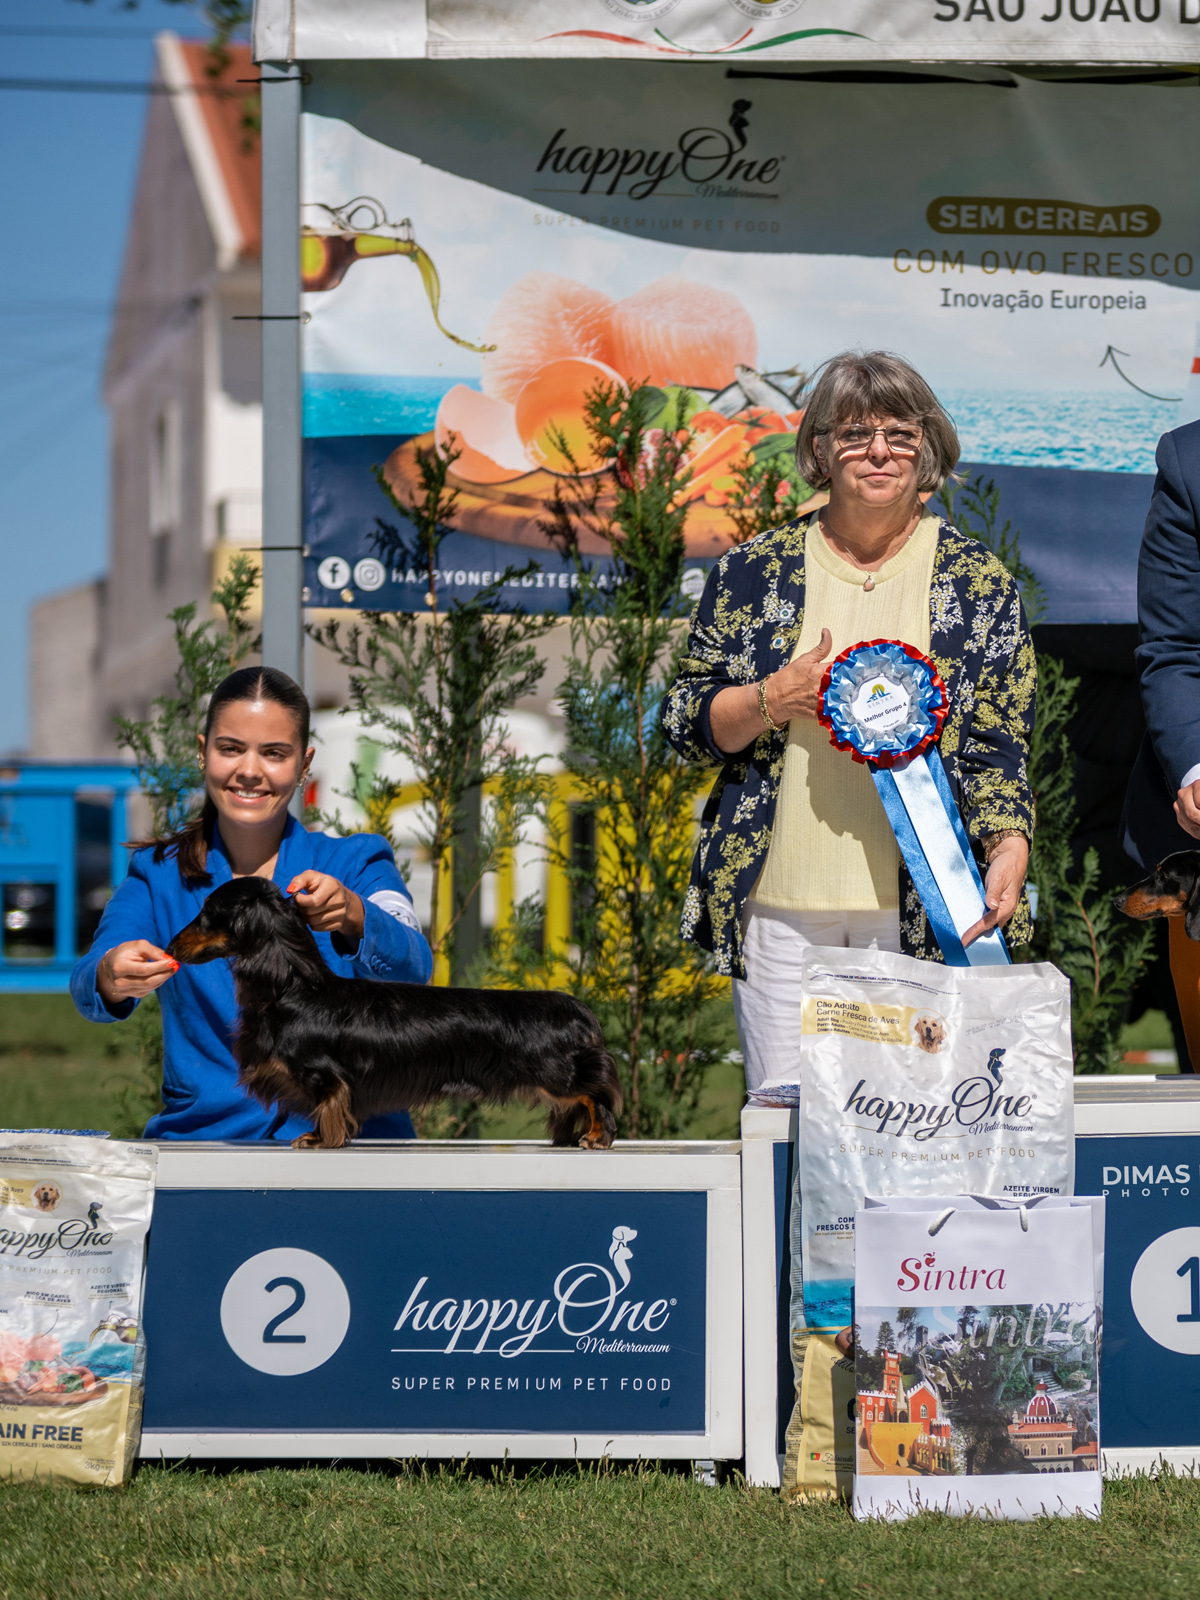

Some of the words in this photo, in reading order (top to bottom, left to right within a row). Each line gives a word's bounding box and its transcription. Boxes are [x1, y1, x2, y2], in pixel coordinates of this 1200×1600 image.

[533, 213, 590, 228] SUPER
[601, 215, 684, 230] PREMIUM
[692, 218, 725, 231] PET
[734, 219, 781, 233] FOOD
[938, 204, 1005, 229] SEM
[1014, 206, 1149, 232] CEREAIS
[893, 248, 964, 274] COM
[981, 250, 1046, 275] OVO
[1062, 251, 1194, 277] FRESCO
[940, 288, 1044, 313] Inovação
[1050, 290, 1147, 314] Europeia
[863, 711, 884, 723] Melhor
[884, 704, 903, 715] Grupo
[816, 1000, 833, 1009] Cão
[833, 1001, 860, 1012] Adulto
[816, 1008, 841, 1016] Carne
[842, 1009, 867, 1022] Fresca
[868, 1015, 879, 1024] de
[880, 1015, 900, 1025] Aves
[968, 1121, 1035, 1136] Mediterraneum
[839, 1143, 884, 1158] SUPER
[891, 1151, 960, 1162] PREMIUM
[967, 1149, 992, 1160] PET
[1001, 1147, 1035, 1158] FOOD
[1002, 1185, 1030, 1193] AZEITE
[1032, 1186, 1060, 1194] VIRGEM
[816, 1223, 850, 1232] FRESCOS
[837, 1216, 855, 1224] COM
[8, 1265, 59, 1275] PREMIUM
[63, 1268, 81, 1276] PET
[86, 1266, 113, 1274] FOOD
[897, 1251, 1007, 1292] Sintra
[262, 1276, 307, 1344] 2
[575, 1335, 671, 1355] Mediterraneum
[391, 1377, 456, 1390] SUPER
[466, 1377, 562, 1391] PREMIUM
[573, 1377, 609, 1391] PET
[620, 1377, 671, 1391] FOOD
[32, 1424, 84, 1443] FREE
